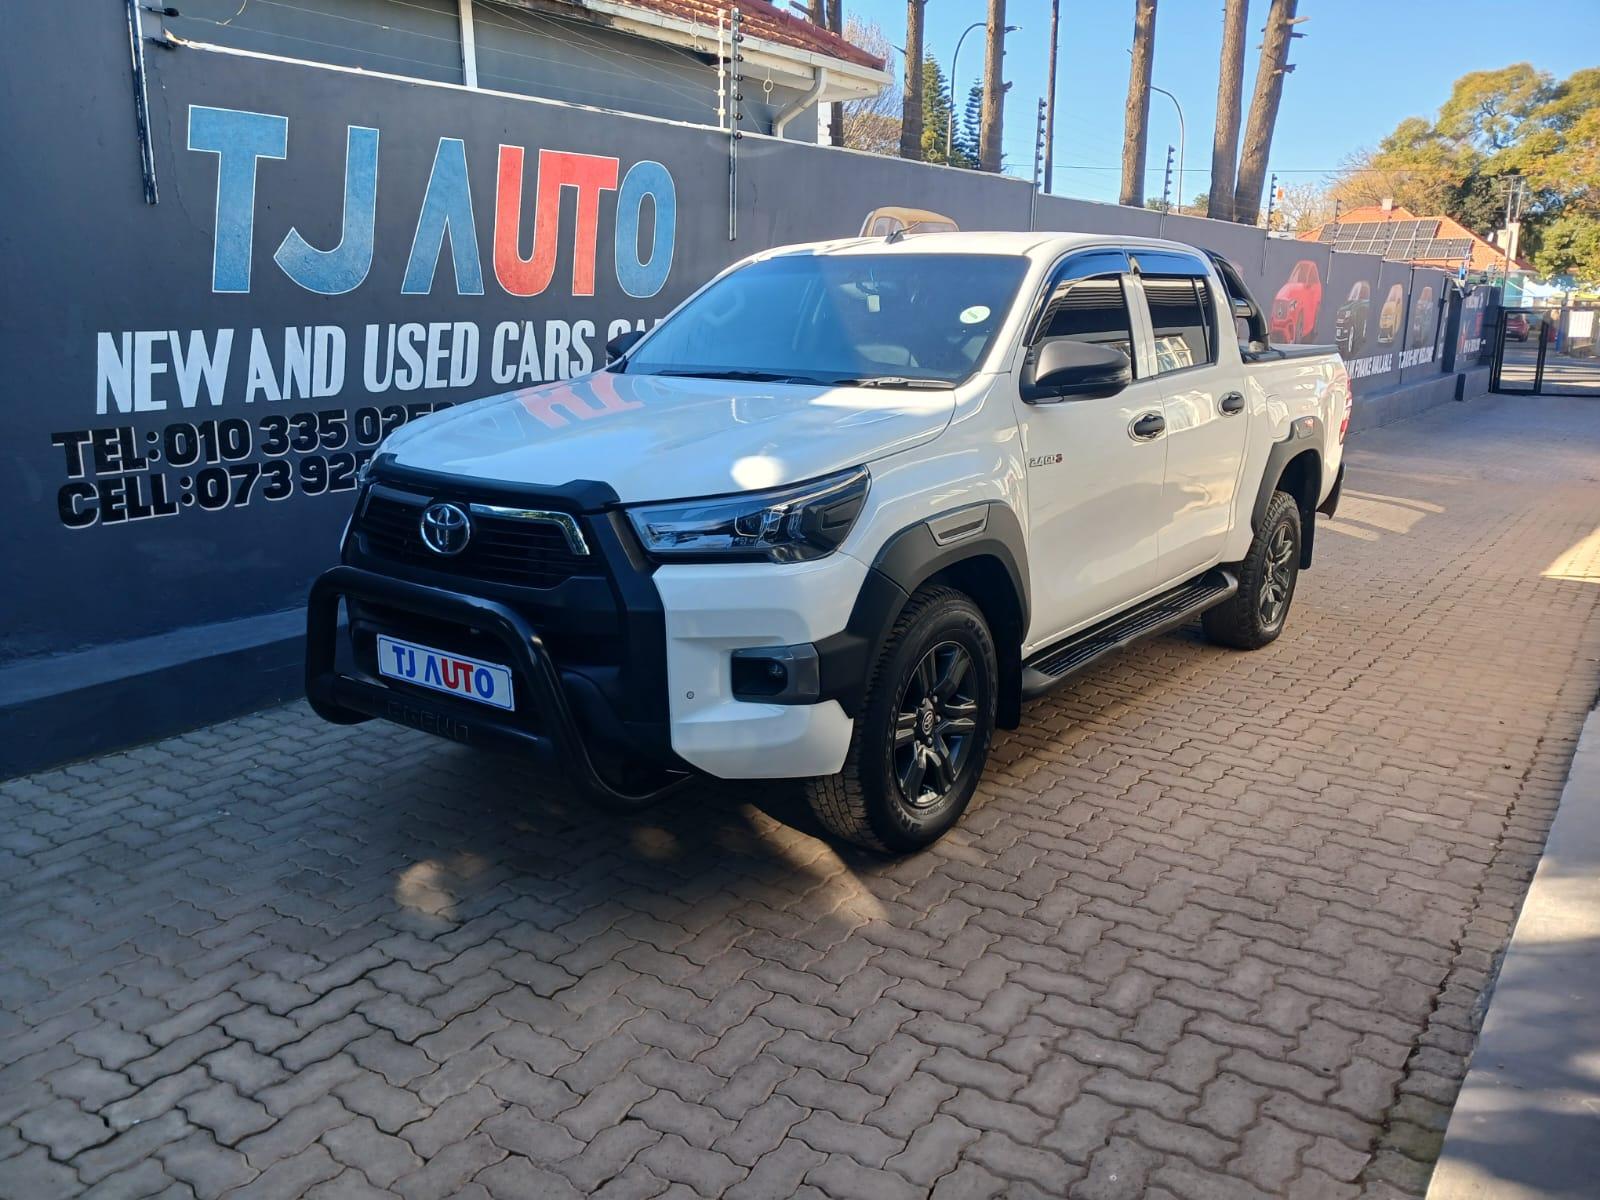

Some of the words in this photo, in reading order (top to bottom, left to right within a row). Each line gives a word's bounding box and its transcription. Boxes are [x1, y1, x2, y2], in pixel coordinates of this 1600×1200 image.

[187, 104, 380, 294] TJ
[400, 137, 677, 297] AUTO
[97, 328, 234, 414] NEW
[245, 325, 346, 402] AND
[363, 321, 480, 393] USED
[491, 319, 595, 384] CARS
[259, 409, 349, 457] 335
[354, 402, 457, 446] 02
[300, 449, 374, 496] 92
[392, 646, 416, 676] TJ
[424, 656, 495, 699] AUTO
